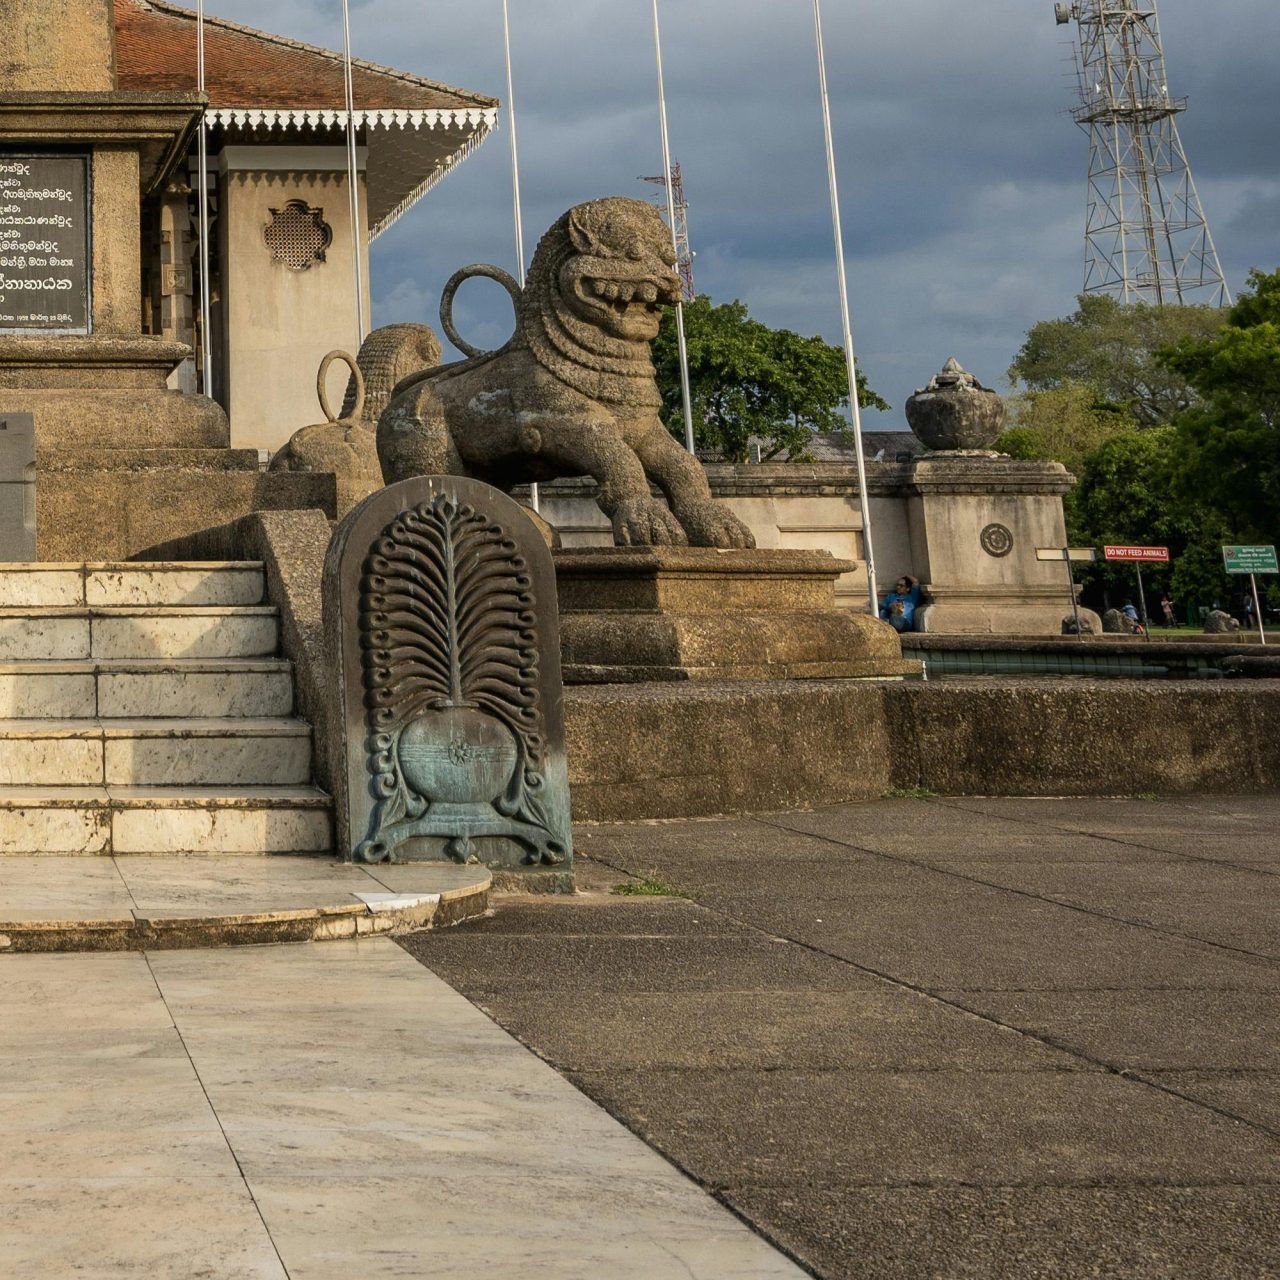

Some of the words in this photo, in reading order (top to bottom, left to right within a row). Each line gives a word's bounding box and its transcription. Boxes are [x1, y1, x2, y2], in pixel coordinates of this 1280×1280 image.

[0, 204, 21, 214] දක්වා
[29, 257, 47, 266] මහා
[1143, 549, 1167, 557] ANIMALS
